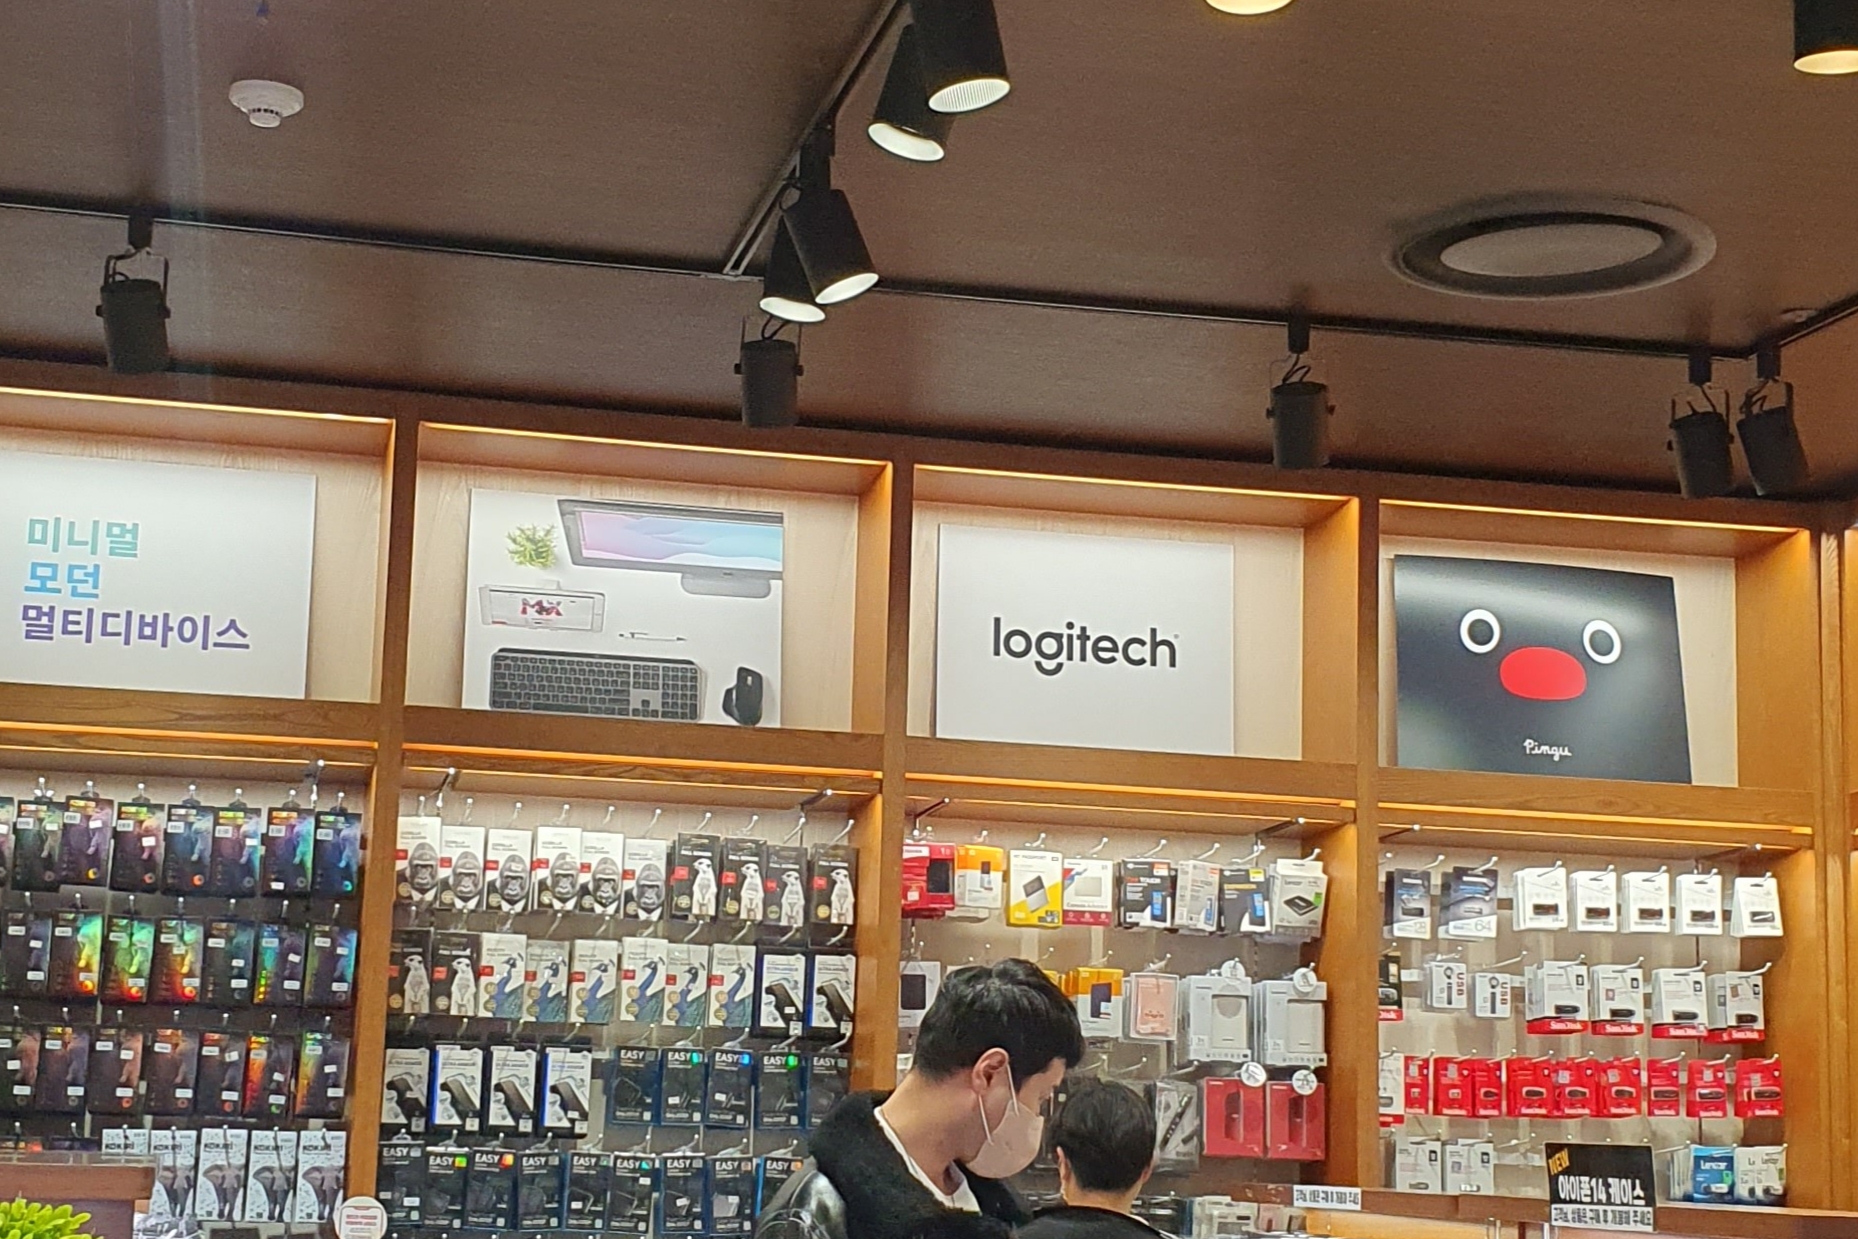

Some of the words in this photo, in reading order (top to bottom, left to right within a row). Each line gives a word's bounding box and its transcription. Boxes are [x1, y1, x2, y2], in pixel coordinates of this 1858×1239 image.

[27, 517, 140, 558] 미니멀
[24, 561, 101, 599] 모던
[21, 604, 251, 650] 멀티디바이스
[993, 616, 1177, 676] logitech
[1523, 738, 1572, 761] Pingu
[1474, 919, 1492, 932] 64
[620, 1050, 644, 1060] EASY
[668, 1052, 691, 1062] EASY
[715, 1053, 738, 1064] EASY
[763, 1056, 787, 1066] EASY
[813, 1057, 836, 1067] EASY
[383, 1147, 408, 1157] EASY
[429, 1156, 453, 1166] EASY
[475, 1153, 500, 1164] EASY
[522, 1156, 546, 1166] EASY
[573, 1156, 597, 1166] EASY
[1548, 1148, 1570, 1175] NEW
[616, 1160, 641, 1170] EASY
[667, 1159, 691, 1169] EASY
[715, 1161, 739, 1171] EASY
[766, 1161, 789, 1171] EASY
[1700, 1160, 1728, 1170] Lexar
[1558, 1175, 1606, 1203] 아이폰14
[1607, 1177, 1646, 1206] 케이스
